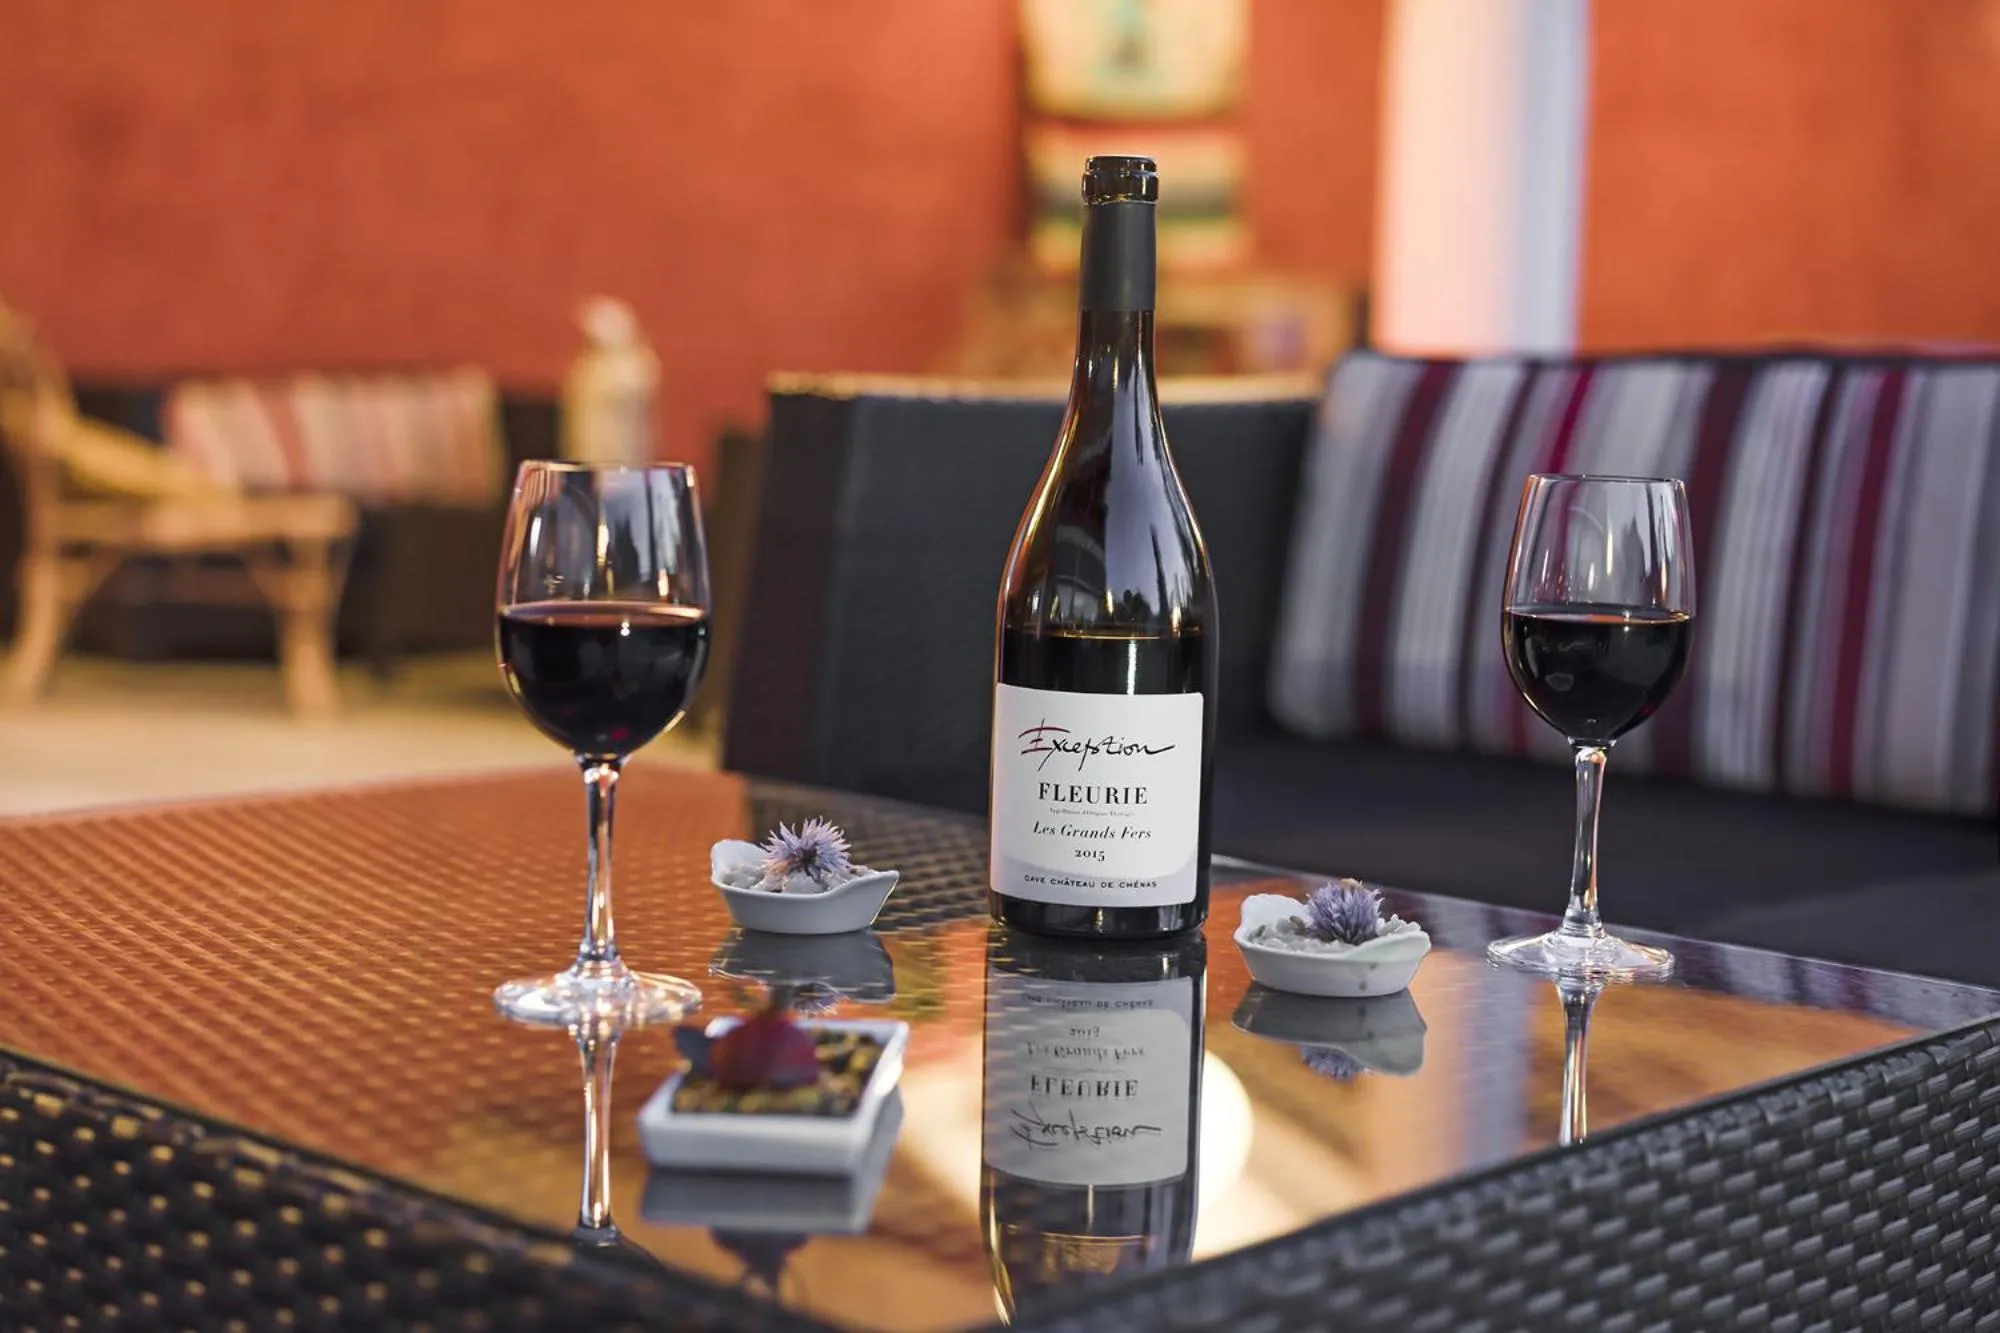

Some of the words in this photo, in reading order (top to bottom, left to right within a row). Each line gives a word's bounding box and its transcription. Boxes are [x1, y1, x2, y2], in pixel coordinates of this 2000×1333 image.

[1018, 718, 1175, 771] Exception
[1039, 782, 1148, 805] FLEURIE
[1033, 821, 1056, 835] Les
[1061, 825, 1116, 840] Grands
[1120, 827, 1152, 840] Fers
[1074, 850, 1105, 862] 2015
[1024, 874, 1045, 883] CAVE
[1050, 877, 1095, 888] CHÂTEAU
[1101, 881, 1114, 889] DE
